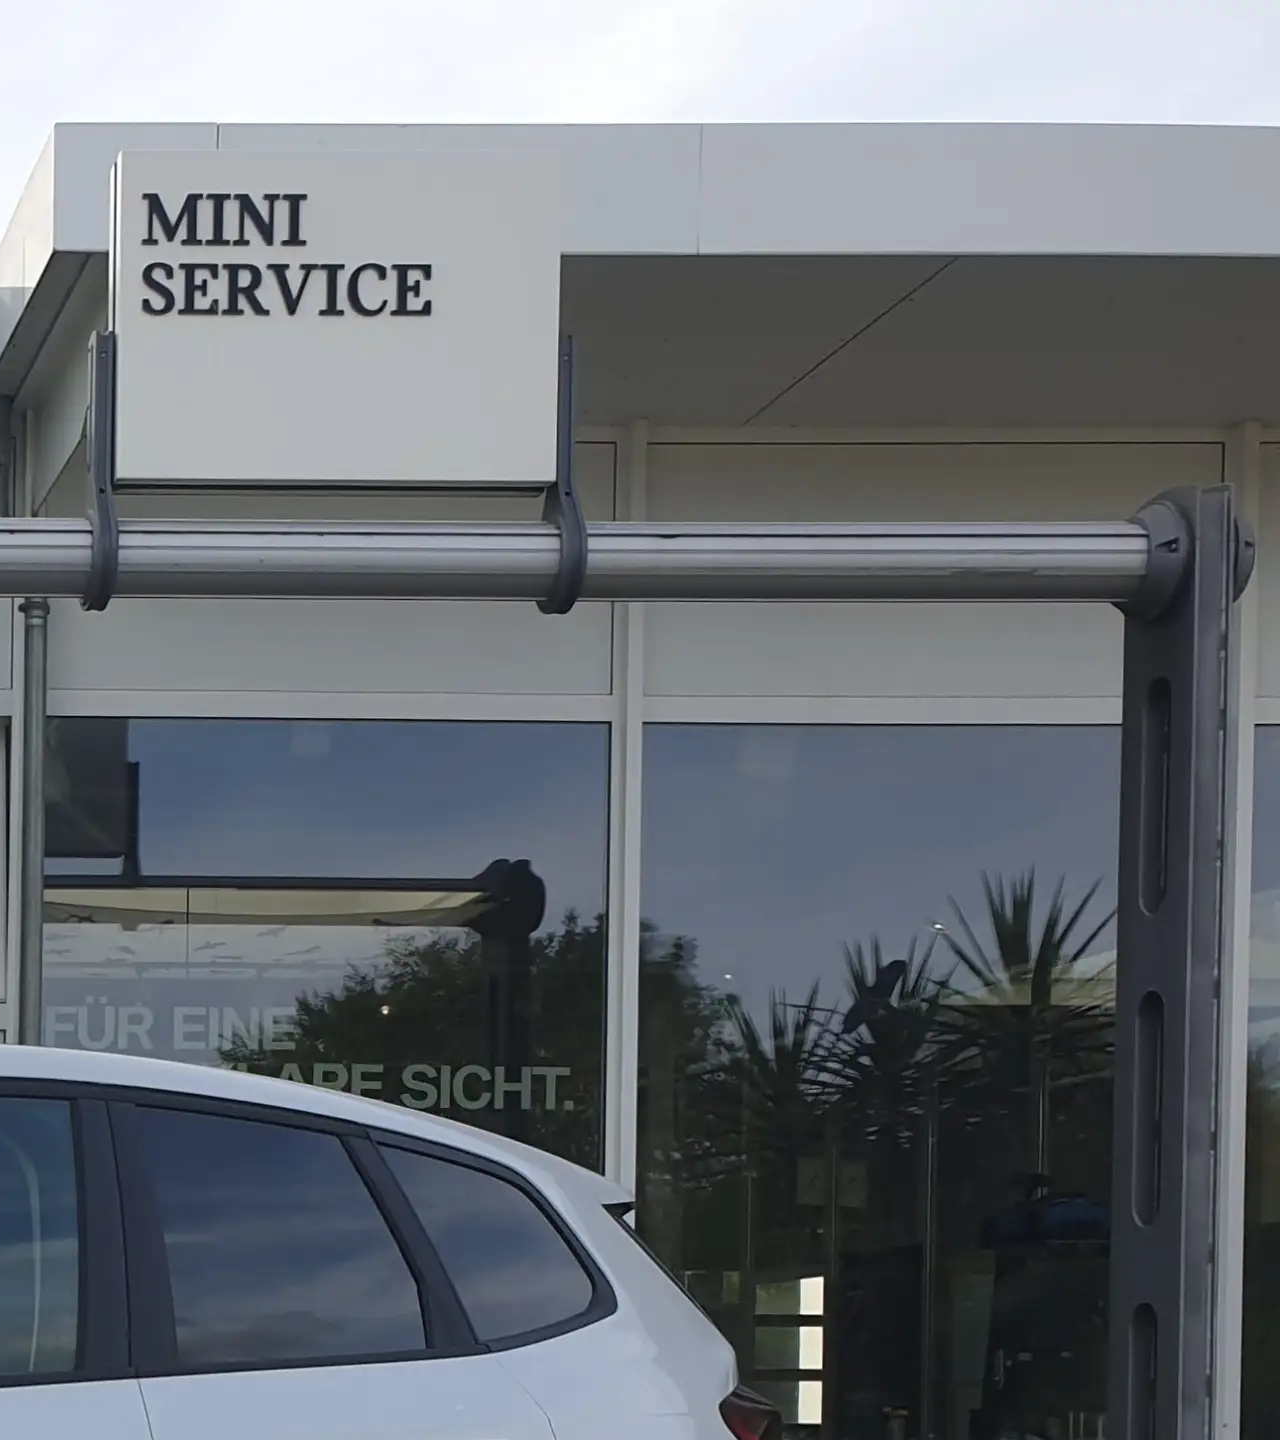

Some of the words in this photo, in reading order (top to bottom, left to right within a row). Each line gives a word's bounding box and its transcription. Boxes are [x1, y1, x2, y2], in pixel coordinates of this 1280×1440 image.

[141, 193, 308, 247] MINI
[141, 262, 433, 317] SERVICE
[45, 995, 154, 1050] FÜR
[173, 1005, 297, 1051] EINE
[400, 1063, 575, 1111] SICHT.
